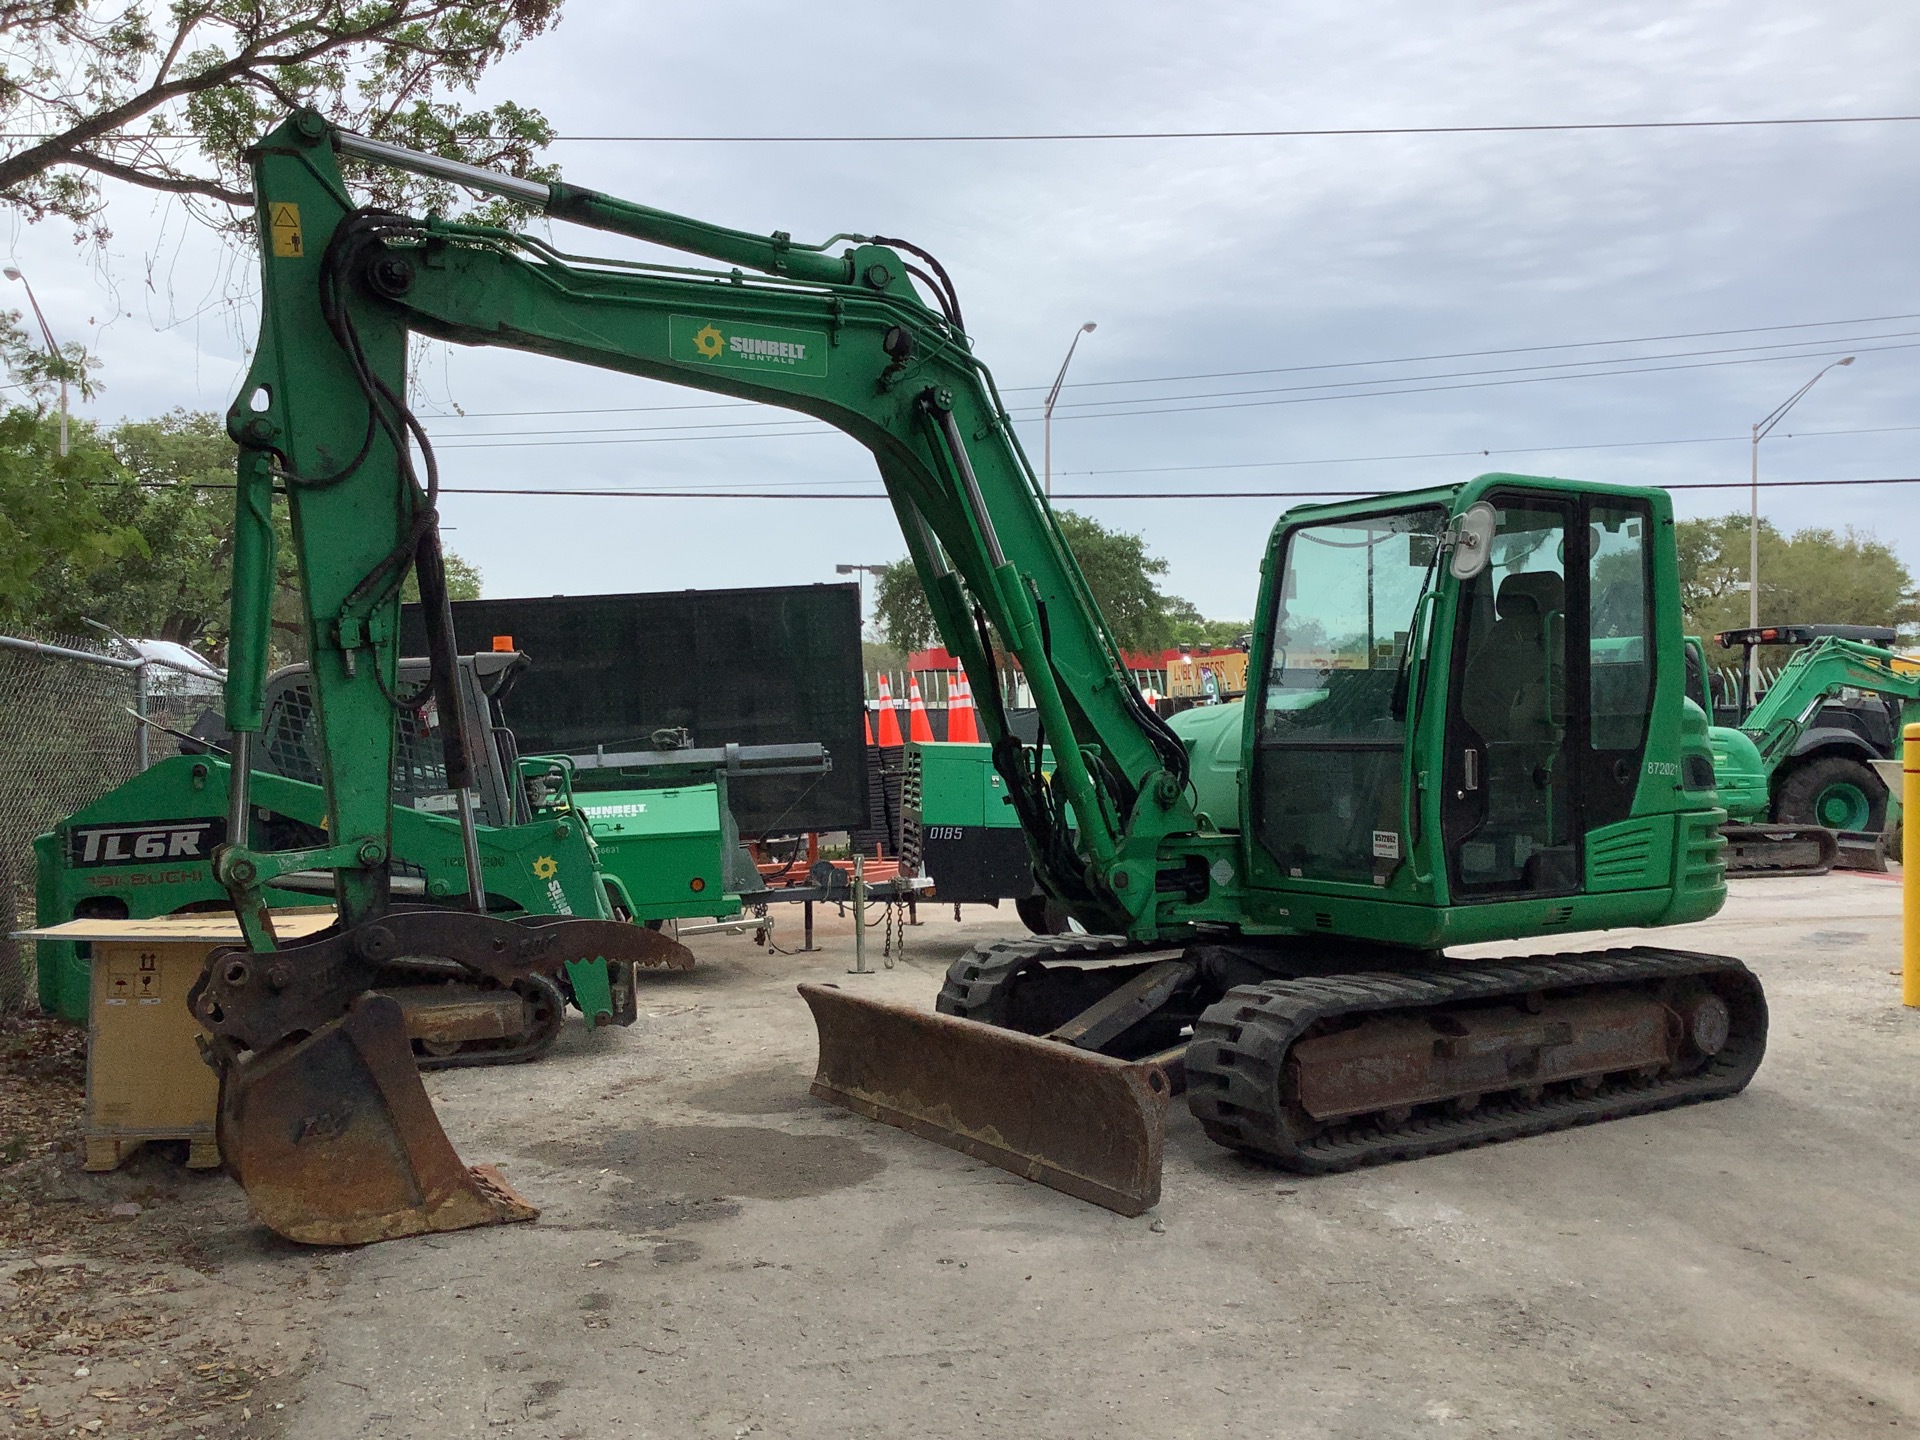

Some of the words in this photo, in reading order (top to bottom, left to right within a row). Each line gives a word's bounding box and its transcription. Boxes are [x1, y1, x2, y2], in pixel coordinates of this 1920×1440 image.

[730, 336, 806, 360] SUNBELT
[740, 352, 795, 365] RENTALS
[1647, 761, 1678, 776] 872021
[582, 803, 647, 816] SUNBELT
[78, 823, 211, 862] TL6R
[547, 879, 573, 916] SUNB
